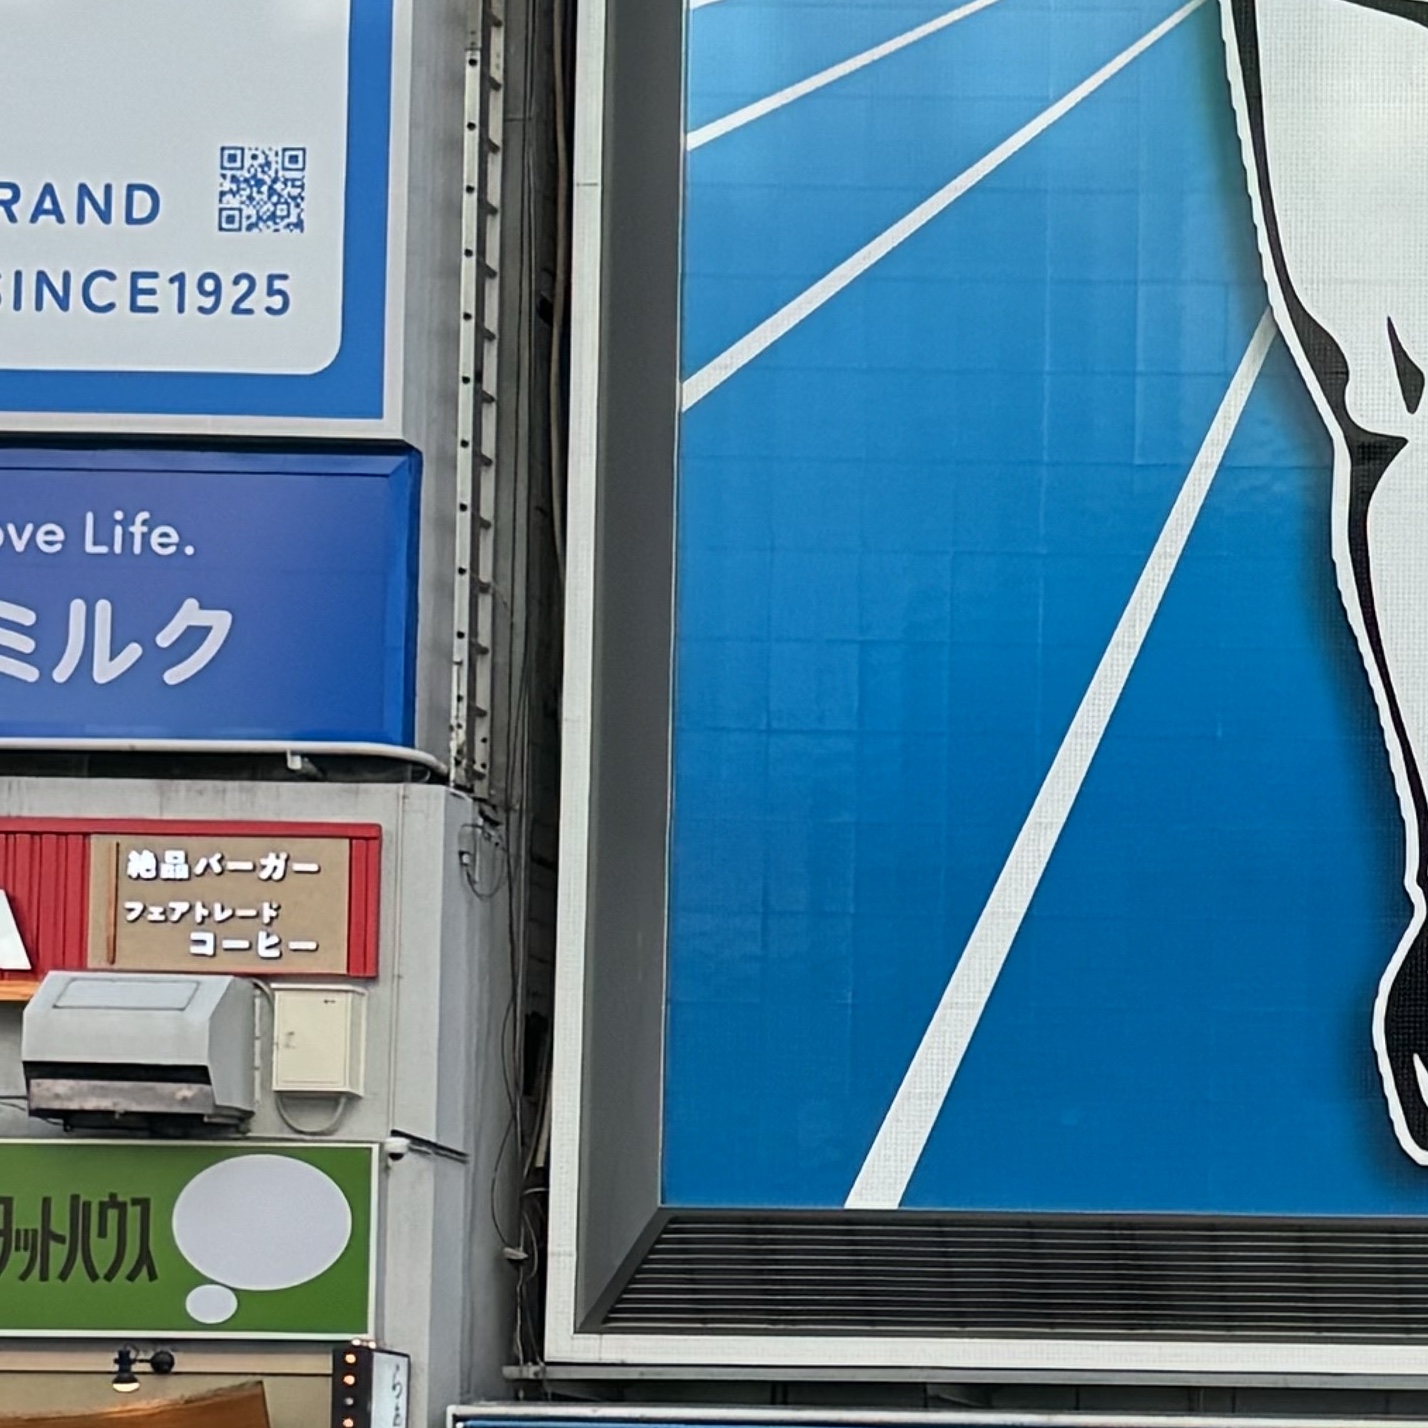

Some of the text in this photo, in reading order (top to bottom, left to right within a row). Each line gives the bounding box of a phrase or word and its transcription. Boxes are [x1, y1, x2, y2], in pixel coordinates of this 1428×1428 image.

[0, 269, 290, 316] INCE1925
[0, 510, 195, 555] ve Life.
[0, 598, 232, 685] ミルク
[127, 849, 320, 882] 絶品バーガー
[123, 901, 281, 924] フェアトレード
[189, 930, 320, 959] コーヒー
